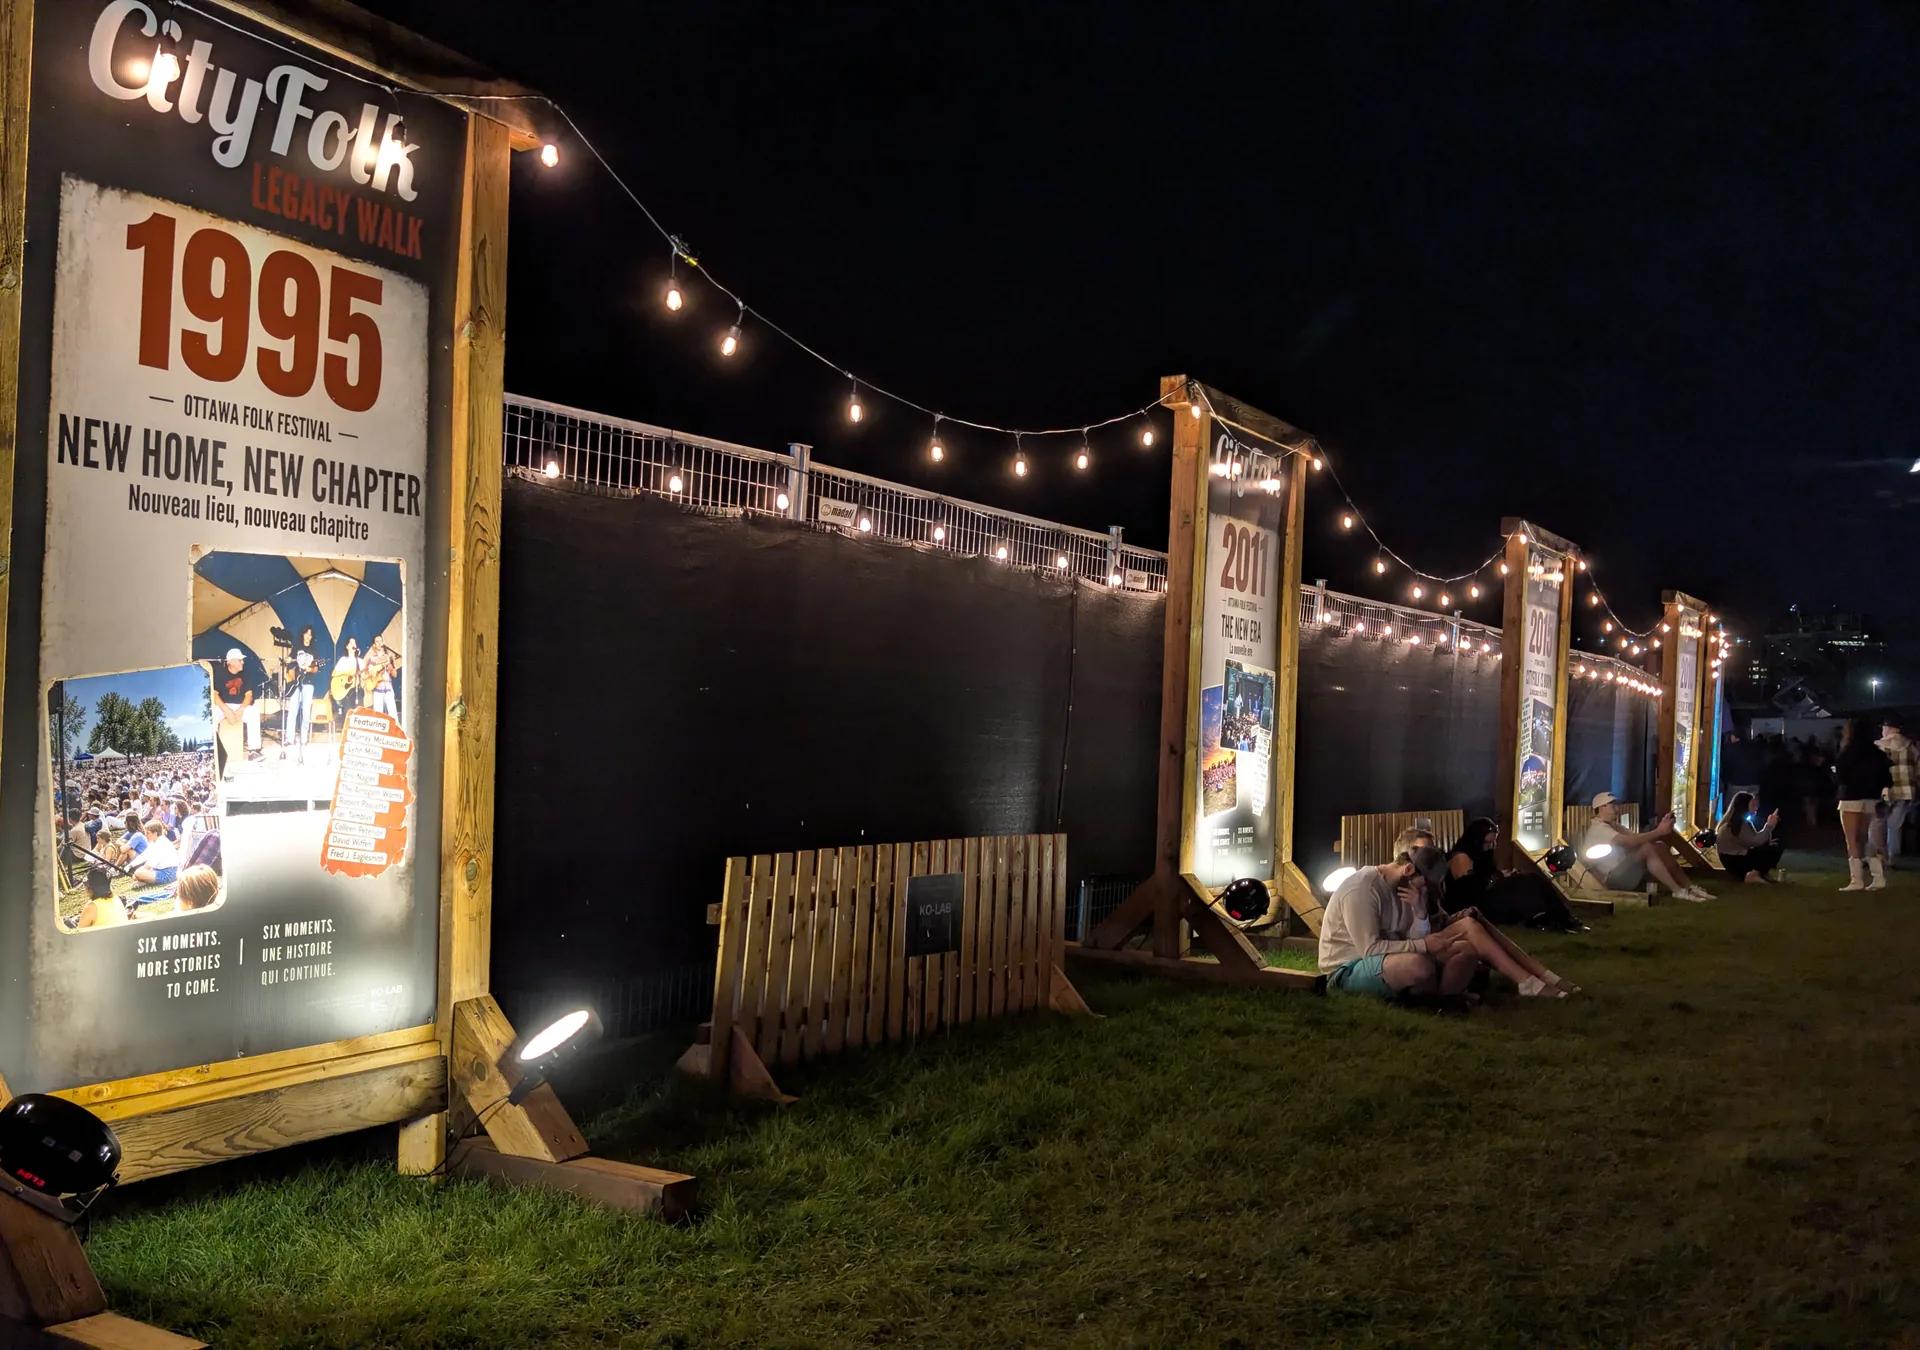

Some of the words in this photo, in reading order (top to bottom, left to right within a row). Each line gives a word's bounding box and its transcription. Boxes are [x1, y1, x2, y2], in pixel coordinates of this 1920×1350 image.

[88, 0, 419, 202] CityFolk
[252, 162, 349, 237] LEGACY
[356, 196, 424, 260] WALK
[126, 212, 383, 413] 1995
[184, 394, 239, 426] OTTAWA
[243, 406, 274, 433] FOLK
[278, 412, 332, 443] FESTIVAL
[57, 413, 132, 473] NEW
[142, 428, 234, 497] HOME,
[244, 445, 304, 499] NEW
[312, 458, 421, 517] CHAPTER
[1216, 434, 1281, 498] CityFol
[128, 484, 200, 520] Nouveau
[205, 495, 239, 528] lieu,
[244, 504, 306, 533] nouveau
[310, 510, 369, 543] chapitre
[1220, 523, 1269, 597] 2011
[1221, 614, 1234, 638] THE
[1235, 617, 1249, 640] NEW
[1250, 620, 1261, 644] ERA
[353, 717, 387, 730] Featuring
[330, 849, 344, 858] Fred
[332, 836, 349, 845] David
[137, 935, 158, 954] SIX
[162, 931, 221, 951] MOMENTS.
[262, 924, 280, 940] SIX
[284, 918, 336, 937] MOMENTS.
[137, 958, 169, 979] MORE
[174, 953, 221, 974] STORIES
[262, 946, 282, 963] UNE
[286, 941, 332, 959] HISTOIRE
[261, 968, 279, 985] QUI
[283, 963, 336, 982] CONTINUE.
[167, 982, 181, 999] TO
[185, 978, 220, 996] COME.
